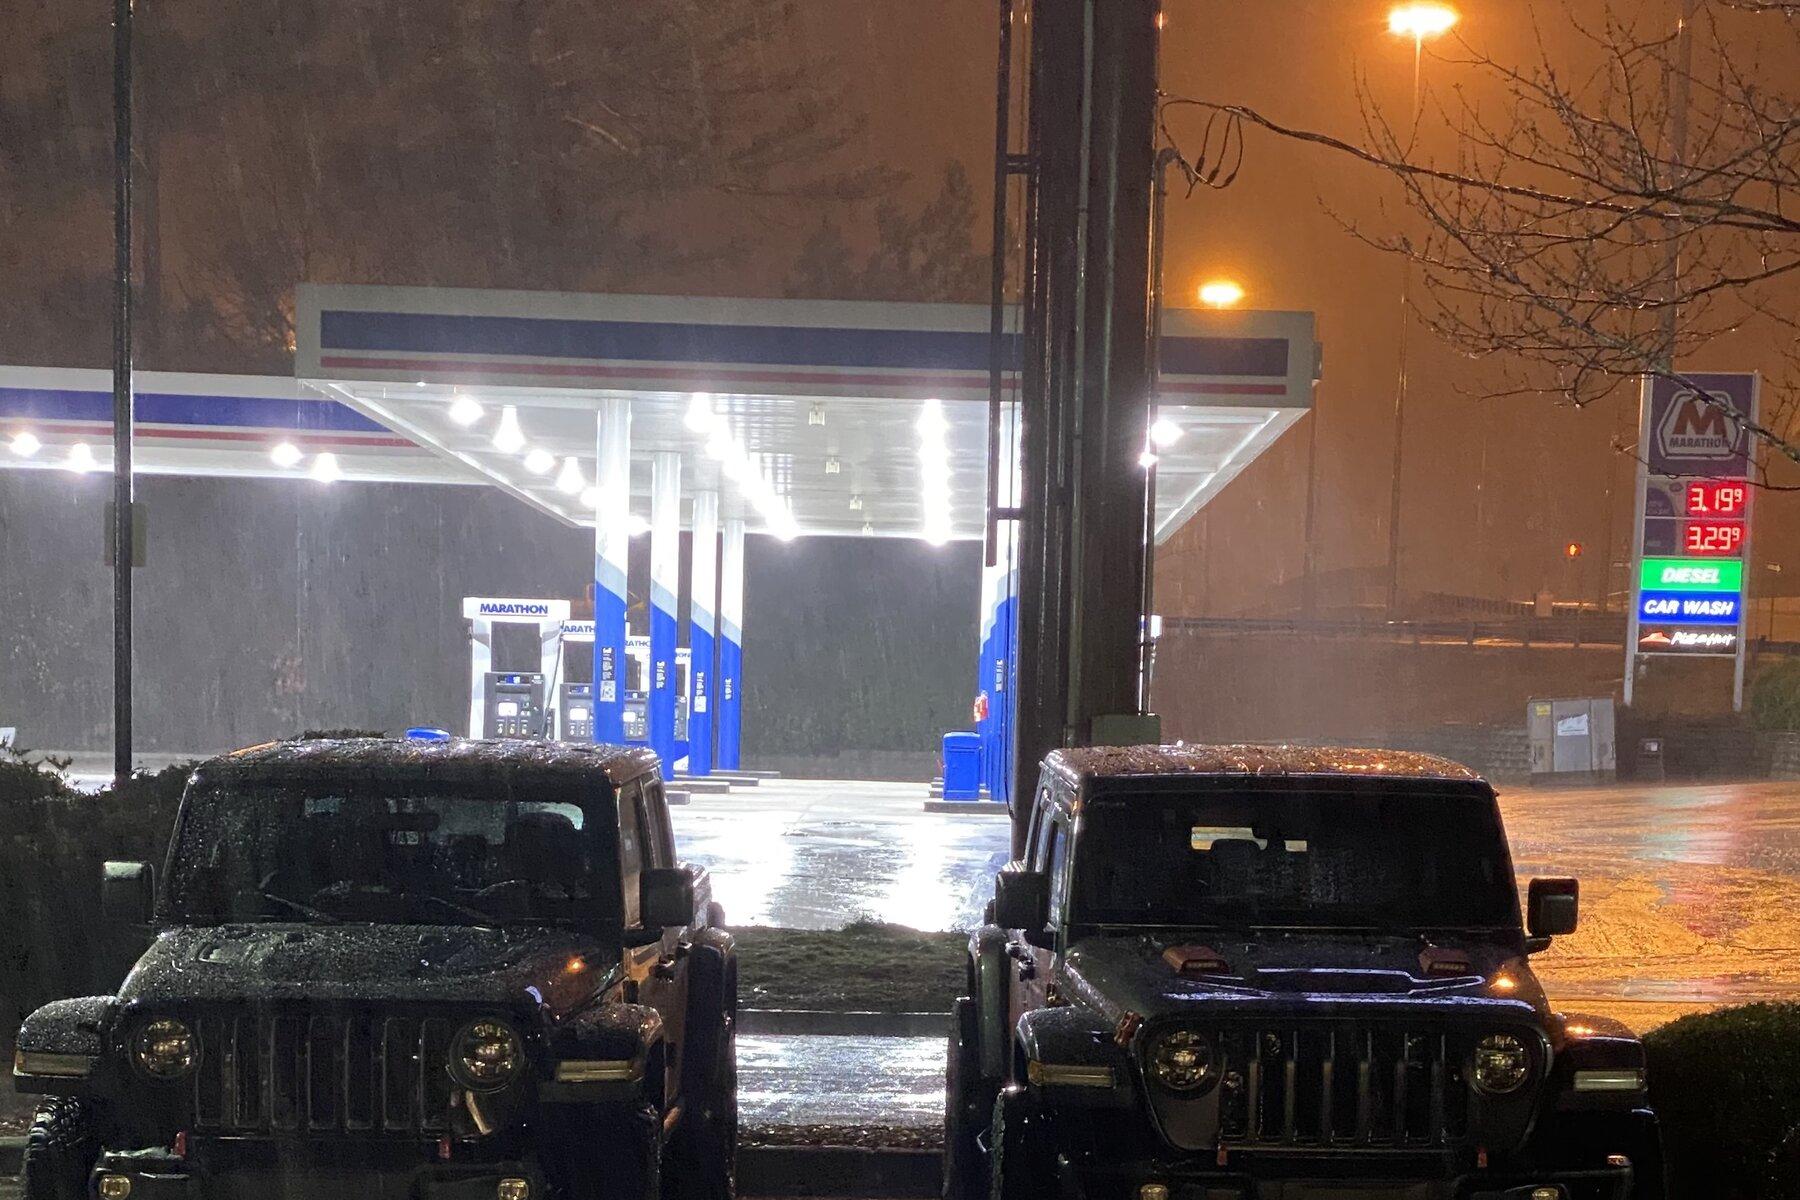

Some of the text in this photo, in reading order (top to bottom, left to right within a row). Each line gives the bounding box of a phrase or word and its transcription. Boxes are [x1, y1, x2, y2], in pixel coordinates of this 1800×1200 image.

[1672, 401, 1728, 435] M
[1669, 437, 1730, 448] MARATHON
[1661, 567, 1720, 584] DIESEL
[480, 603, 548, 614] MARATHON
[1644, 600, 1734, 615] CAR WASH
[560, 625, 596, 633] ARATH
